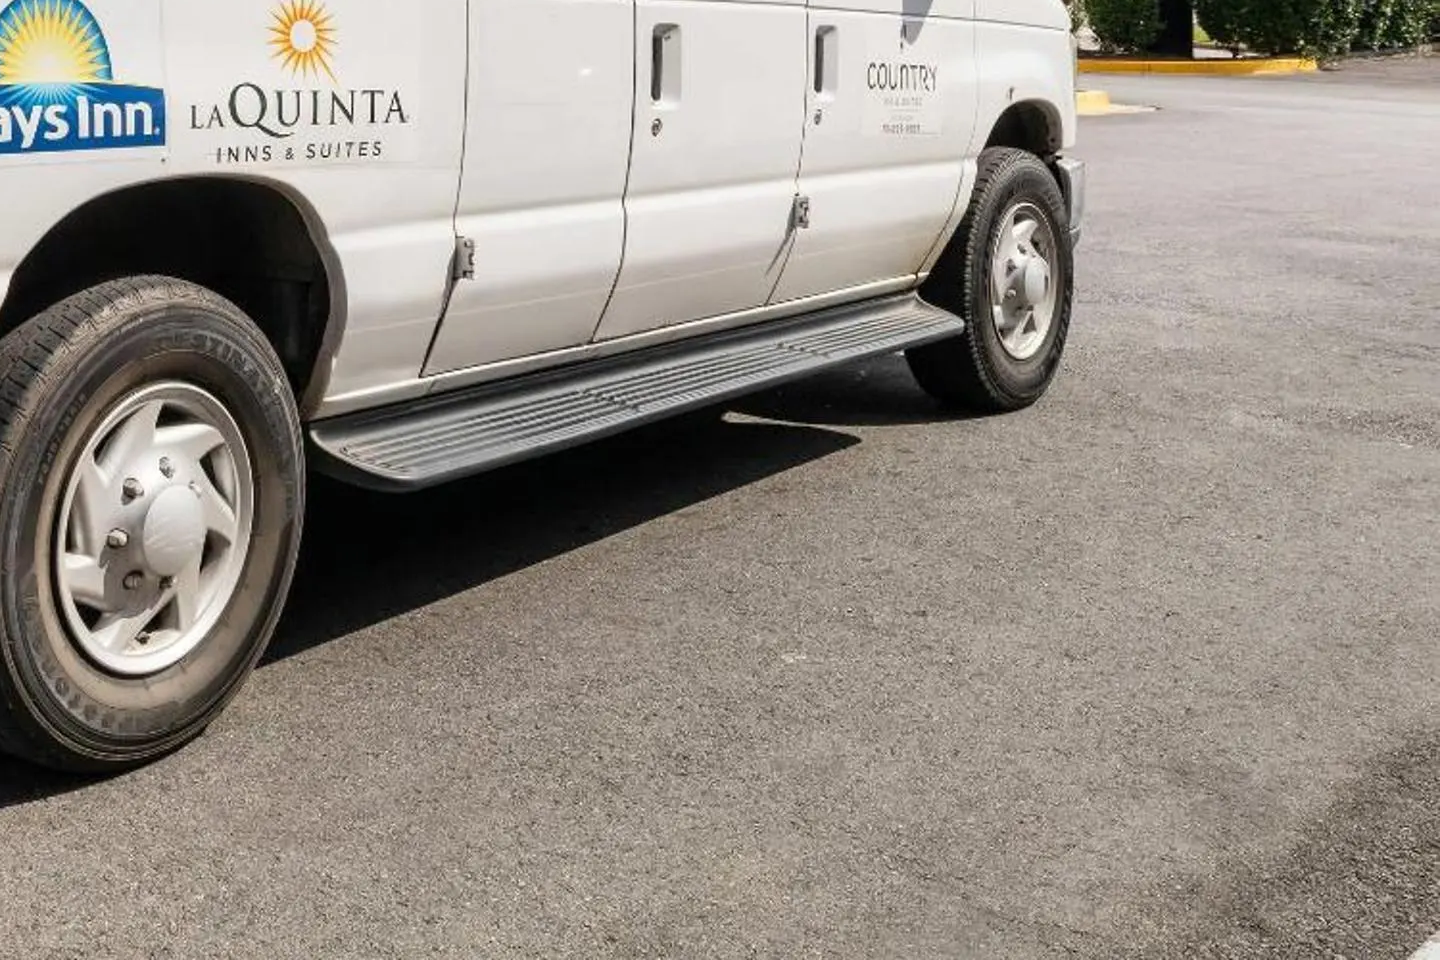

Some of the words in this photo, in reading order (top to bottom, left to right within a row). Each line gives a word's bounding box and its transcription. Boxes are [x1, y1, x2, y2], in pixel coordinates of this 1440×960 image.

[867, 62, 938, 91] COUNTRY
[77, 95, 153, 139] Inn
[190, 104, 225, 130] LA
[228, 82, 408, 139] QUINTA
[216, 145, 272, 164] INNS
[285, 147, 295, 160] &
[306, 141, 382, 159] SUITES
